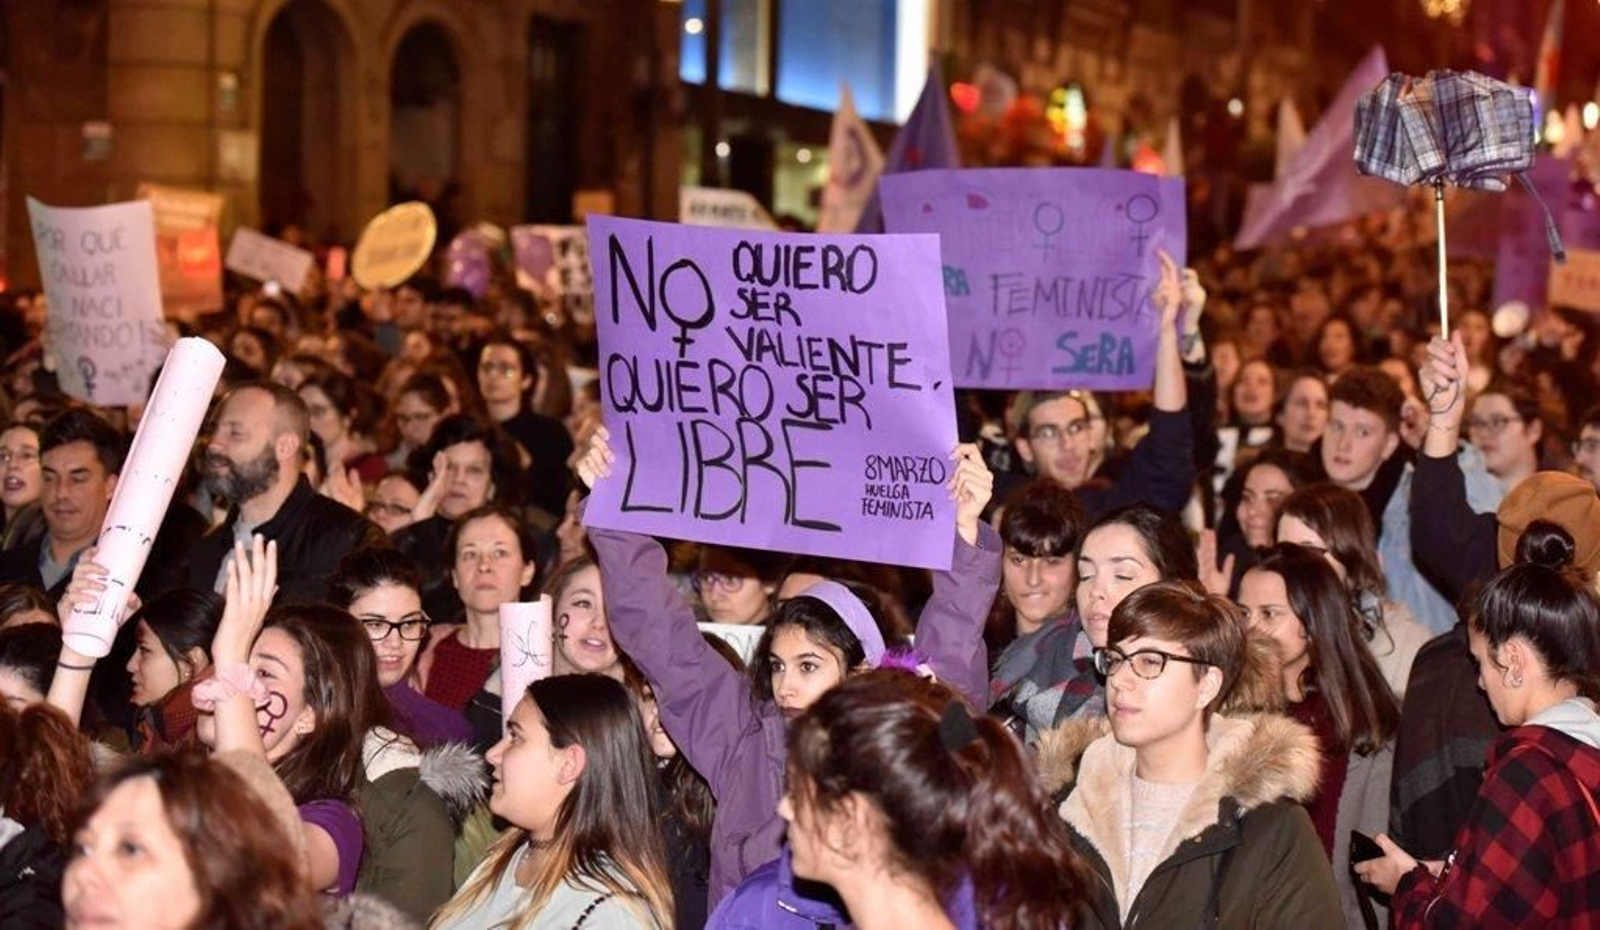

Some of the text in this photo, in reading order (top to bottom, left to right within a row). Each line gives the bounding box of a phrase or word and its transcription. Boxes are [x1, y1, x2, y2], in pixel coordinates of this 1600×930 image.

[608, 233, 716, 357] NO
[731, 240, 879, 295] QUIERO
[730, 287, 802, 327] SER
[1051, 330, 1136, 375] SERA
[607, 352, 873, 431] QUIERO SER
[620, 417, 842, 532] LIBRE
[865, 483, 910, 500] HUELGA
[861, 498, 934, 520] FEMINISTA
